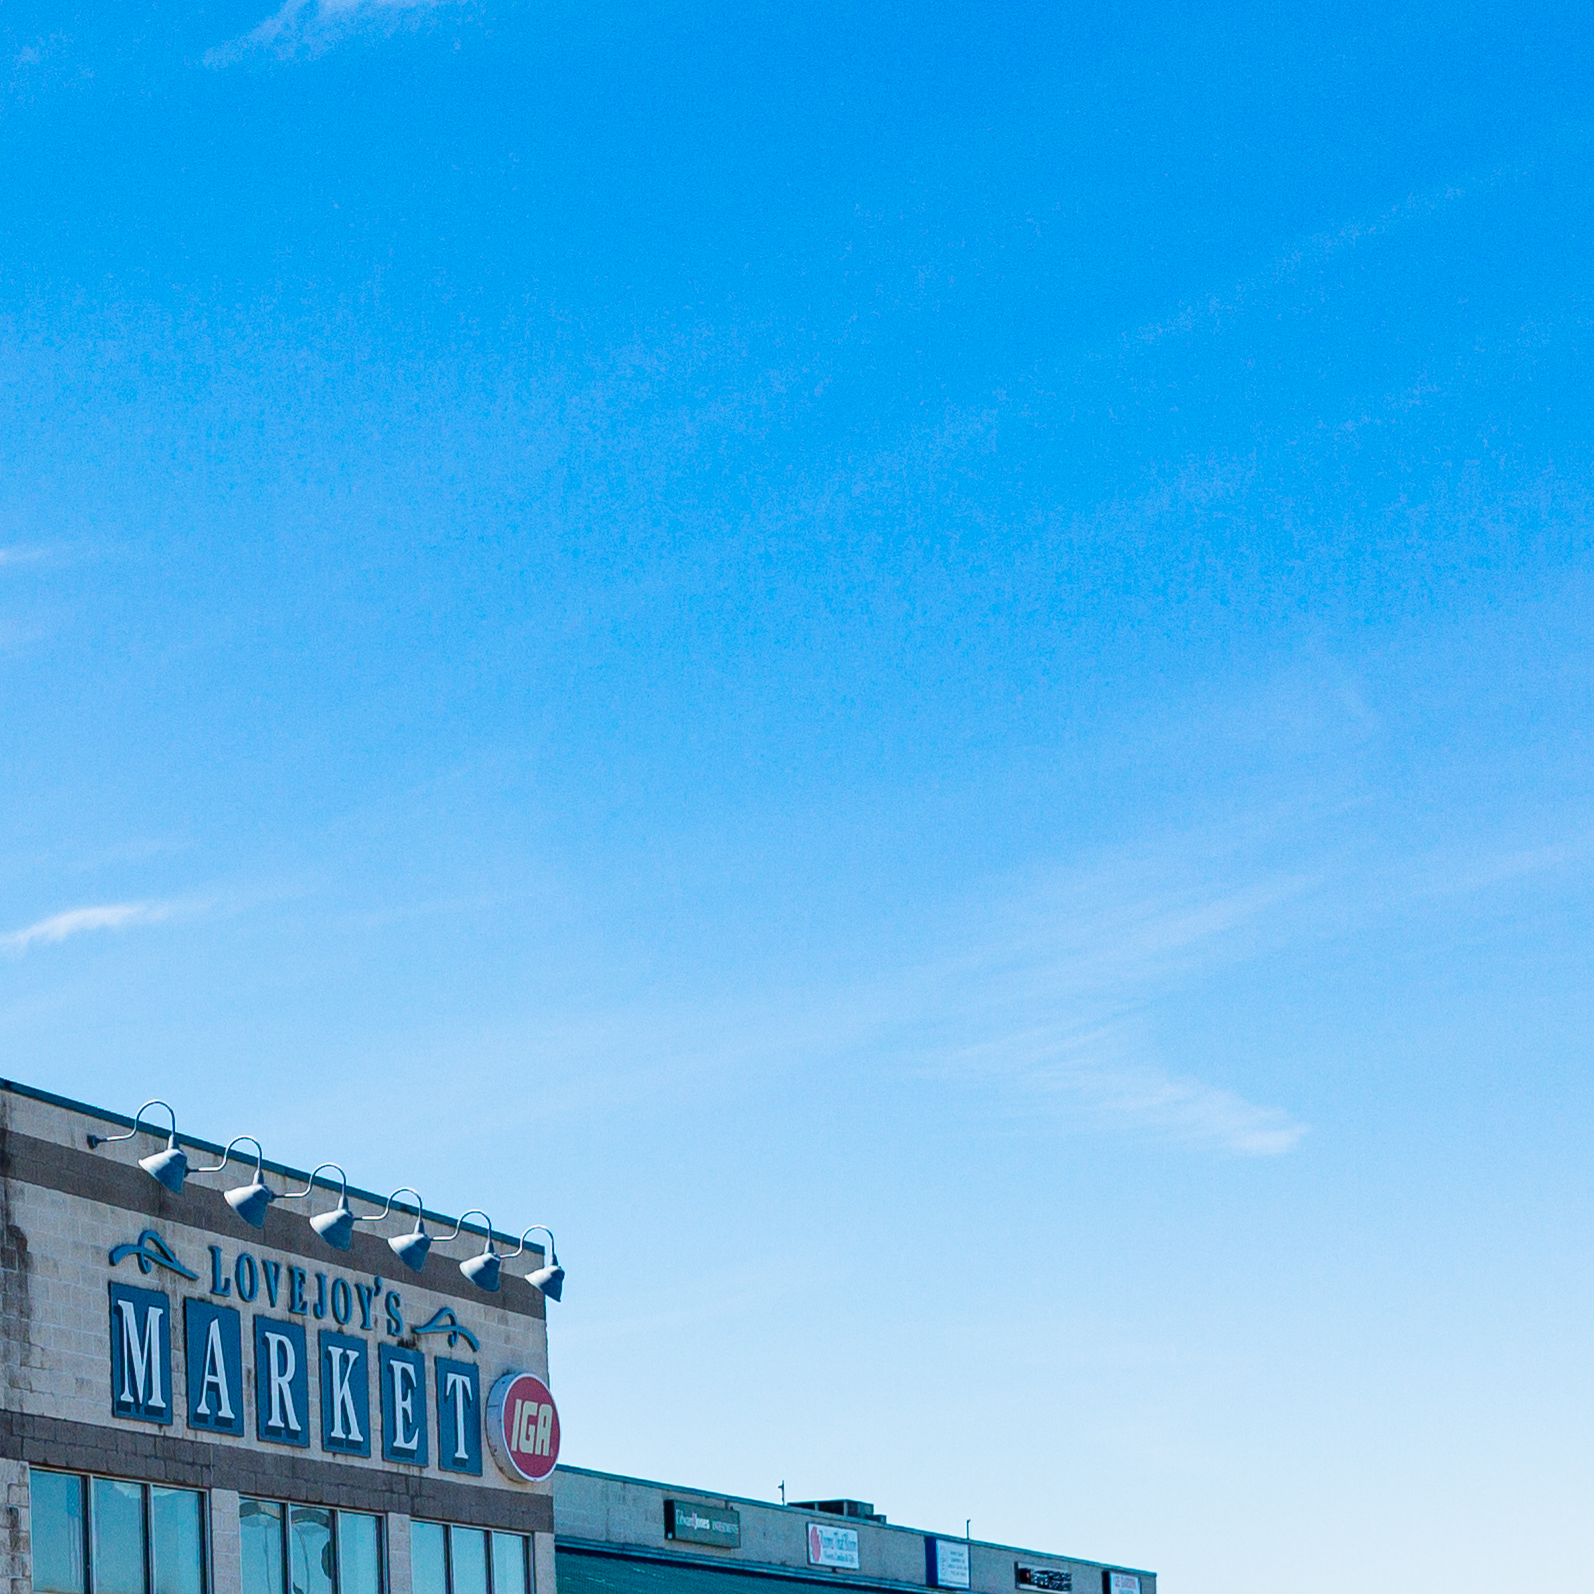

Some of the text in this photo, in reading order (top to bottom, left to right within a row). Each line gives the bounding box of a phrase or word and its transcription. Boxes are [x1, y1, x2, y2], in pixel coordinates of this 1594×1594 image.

[208, 1245, 404, 1337] LOVEJOY'S
[117, 1298, 473, 1461] MARKET
[512, 1397, 553, 1458] IGA
